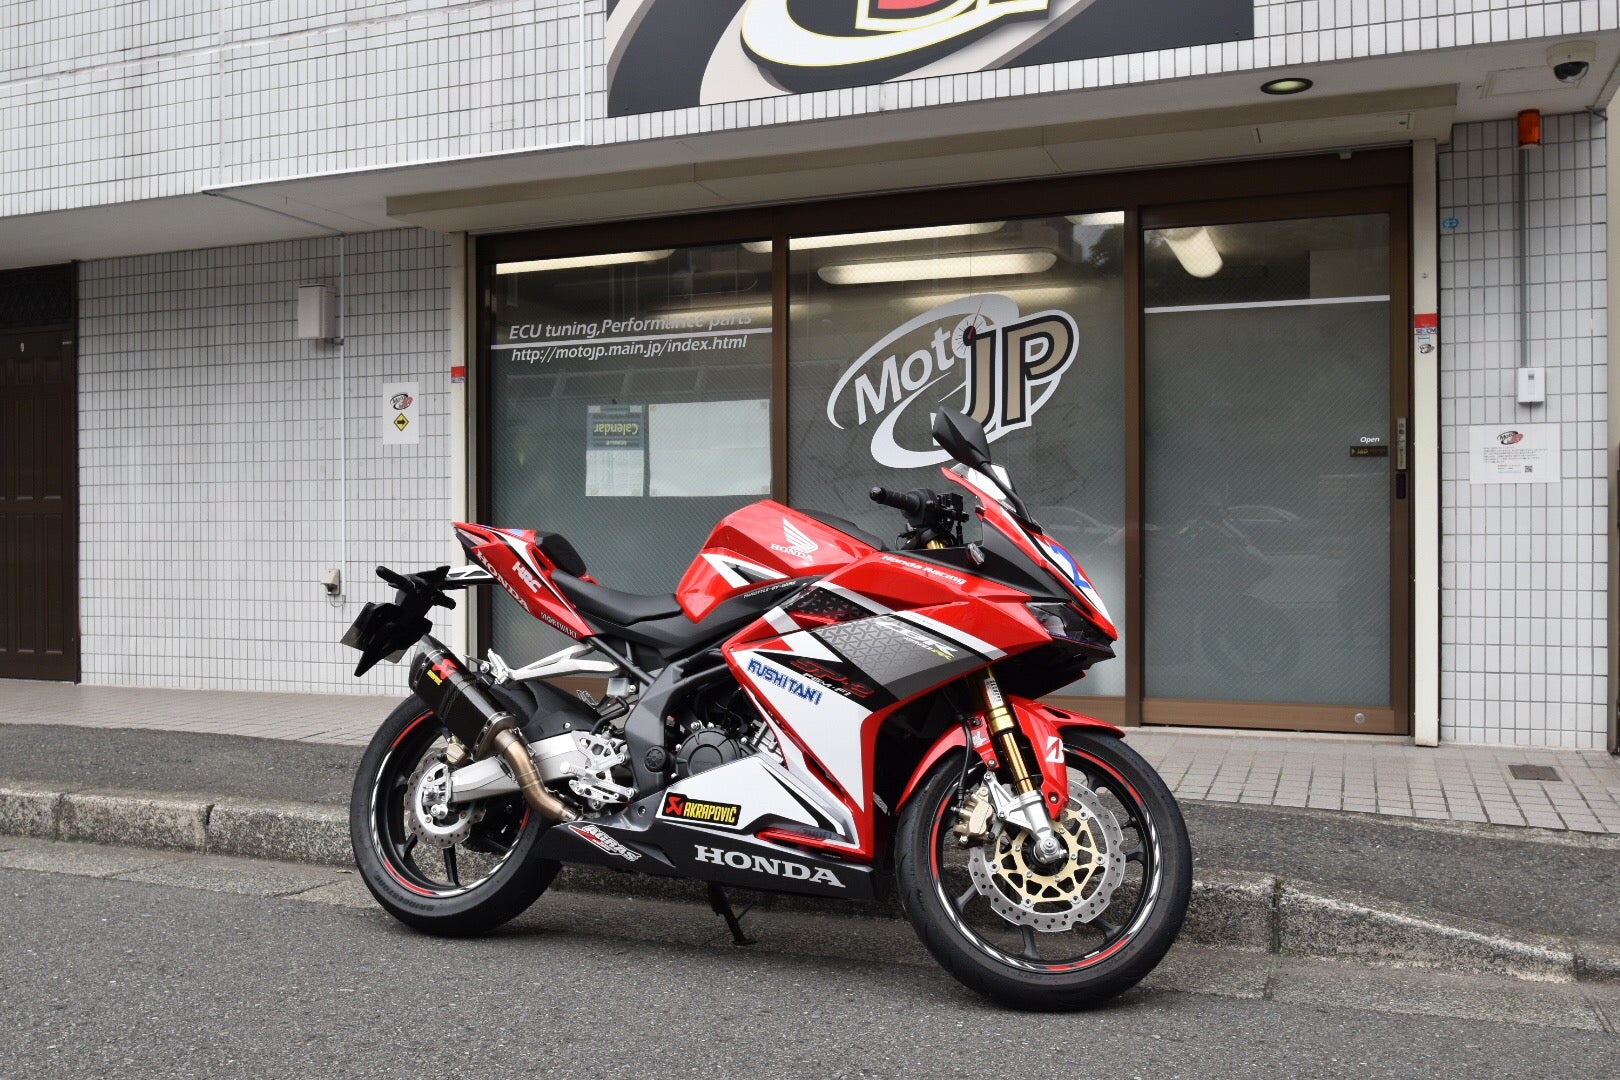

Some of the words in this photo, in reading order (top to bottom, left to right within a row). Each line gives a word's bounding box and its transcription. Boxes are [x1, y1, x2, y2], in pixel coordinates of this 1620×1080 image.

[509, 324, 541, 339] ECU
[709, 311, 753, 330] parts
[512, 335, 747, 362] http://motojp.main.jp/index.html
[962, 310, 1079, 432] JP
[594, 423, 639, 436] Calendar
[1360, 436, 1380, 444] Open
[770, 544, 814, 561] HONDA
[476, 549, 530, 613] HONDA
[512, 561, 542, 594] HRC
[882, 555, 922, 570] Honda
[924, 566, 966, 585] Racing
[747, 657, 823, 706] KUSHITANI
[694, 844, 846, 888] HONDA
